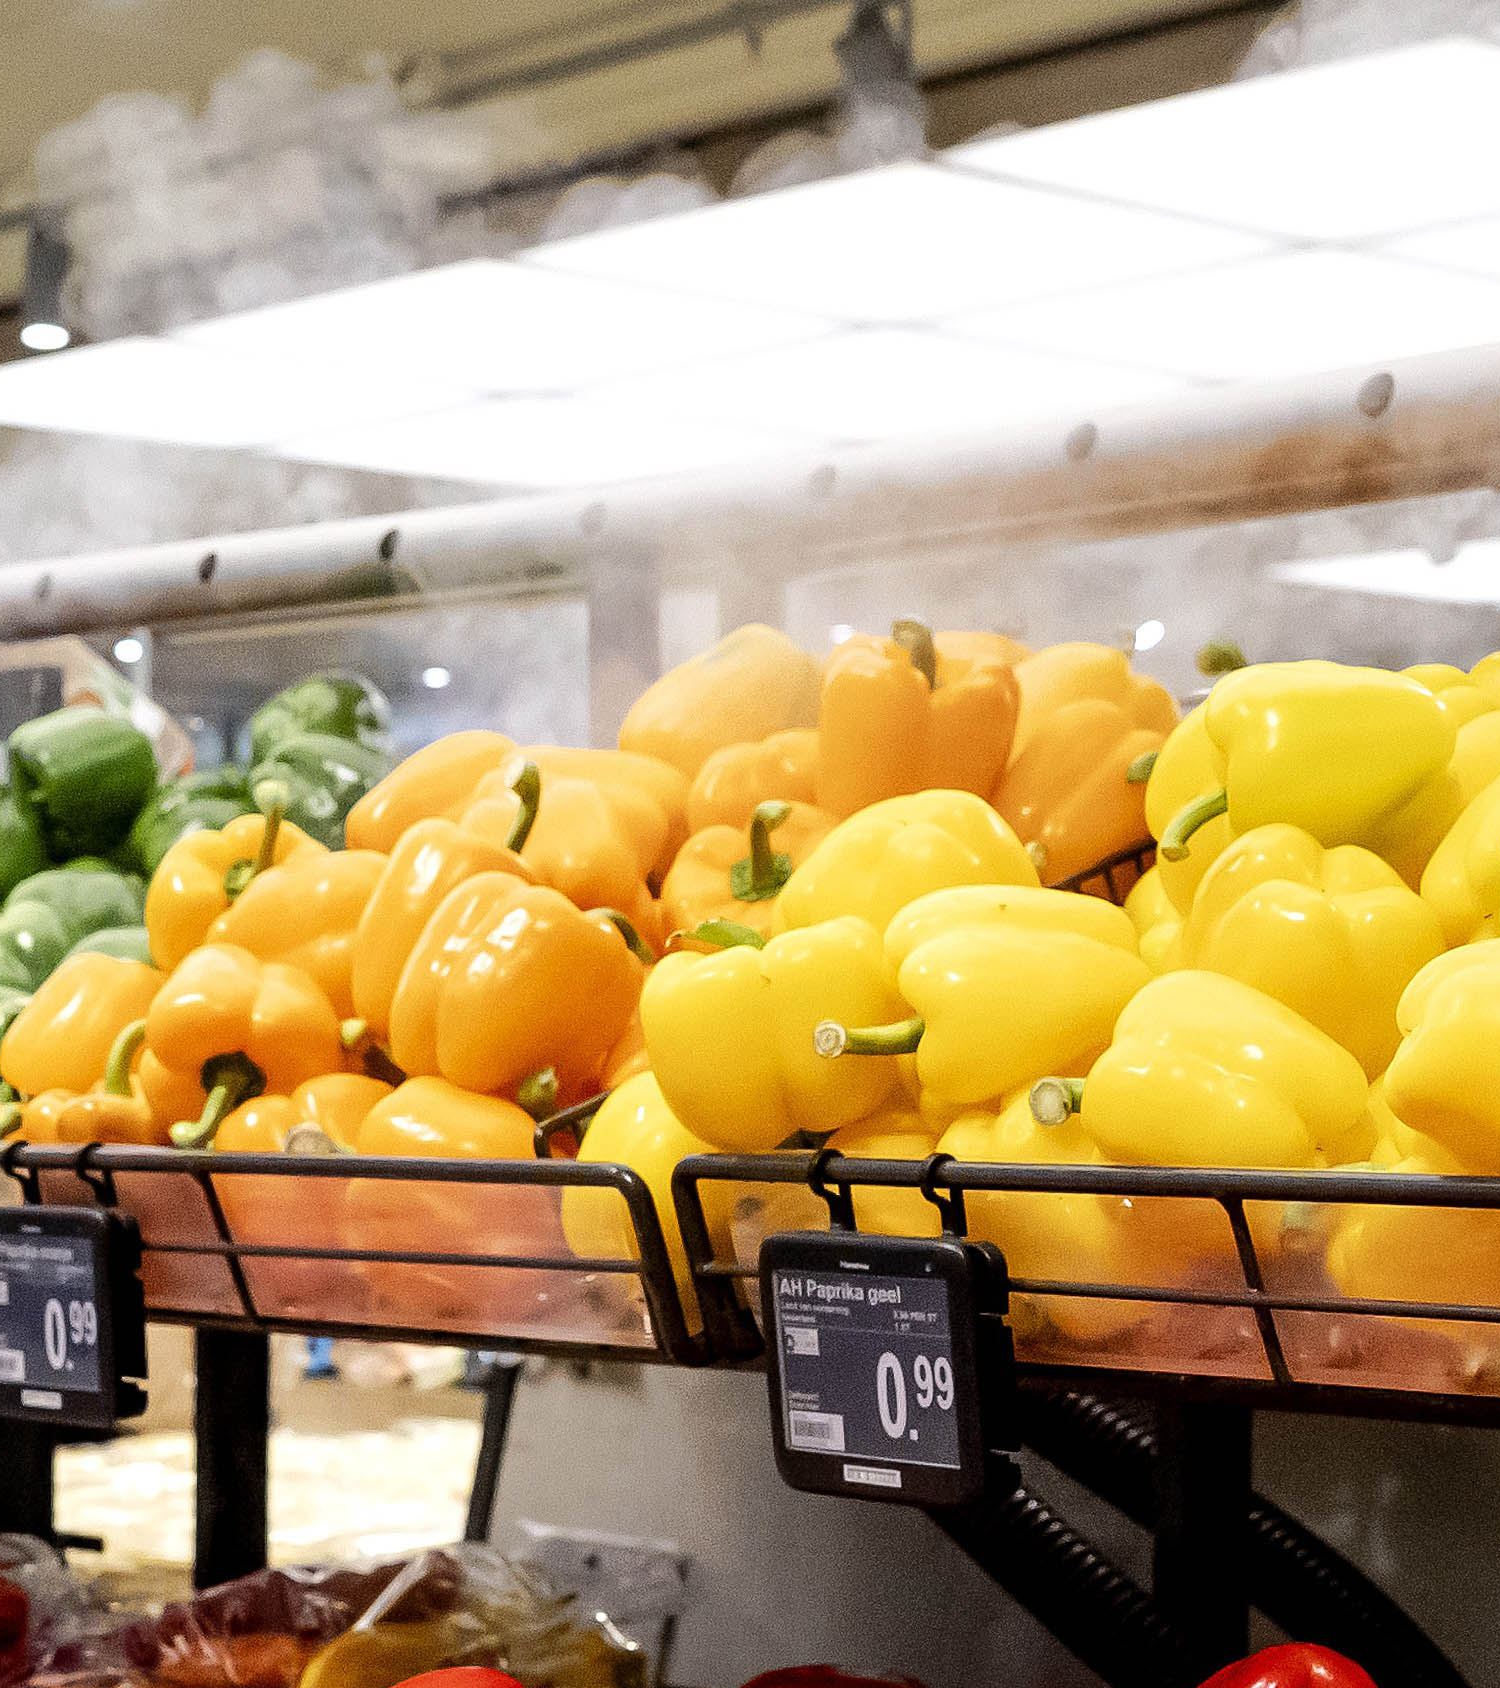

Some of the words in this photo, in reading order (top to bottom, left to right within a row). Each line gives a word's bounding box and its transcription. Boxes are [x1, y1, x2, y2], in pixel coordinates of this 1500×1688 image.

[780, 1278, 802, 1297] AH
[806, 1278, 865, 1303] Paprika
[868, 1284, 901, 1306] geel
[877, 1351, 954, 1441] 0.99
